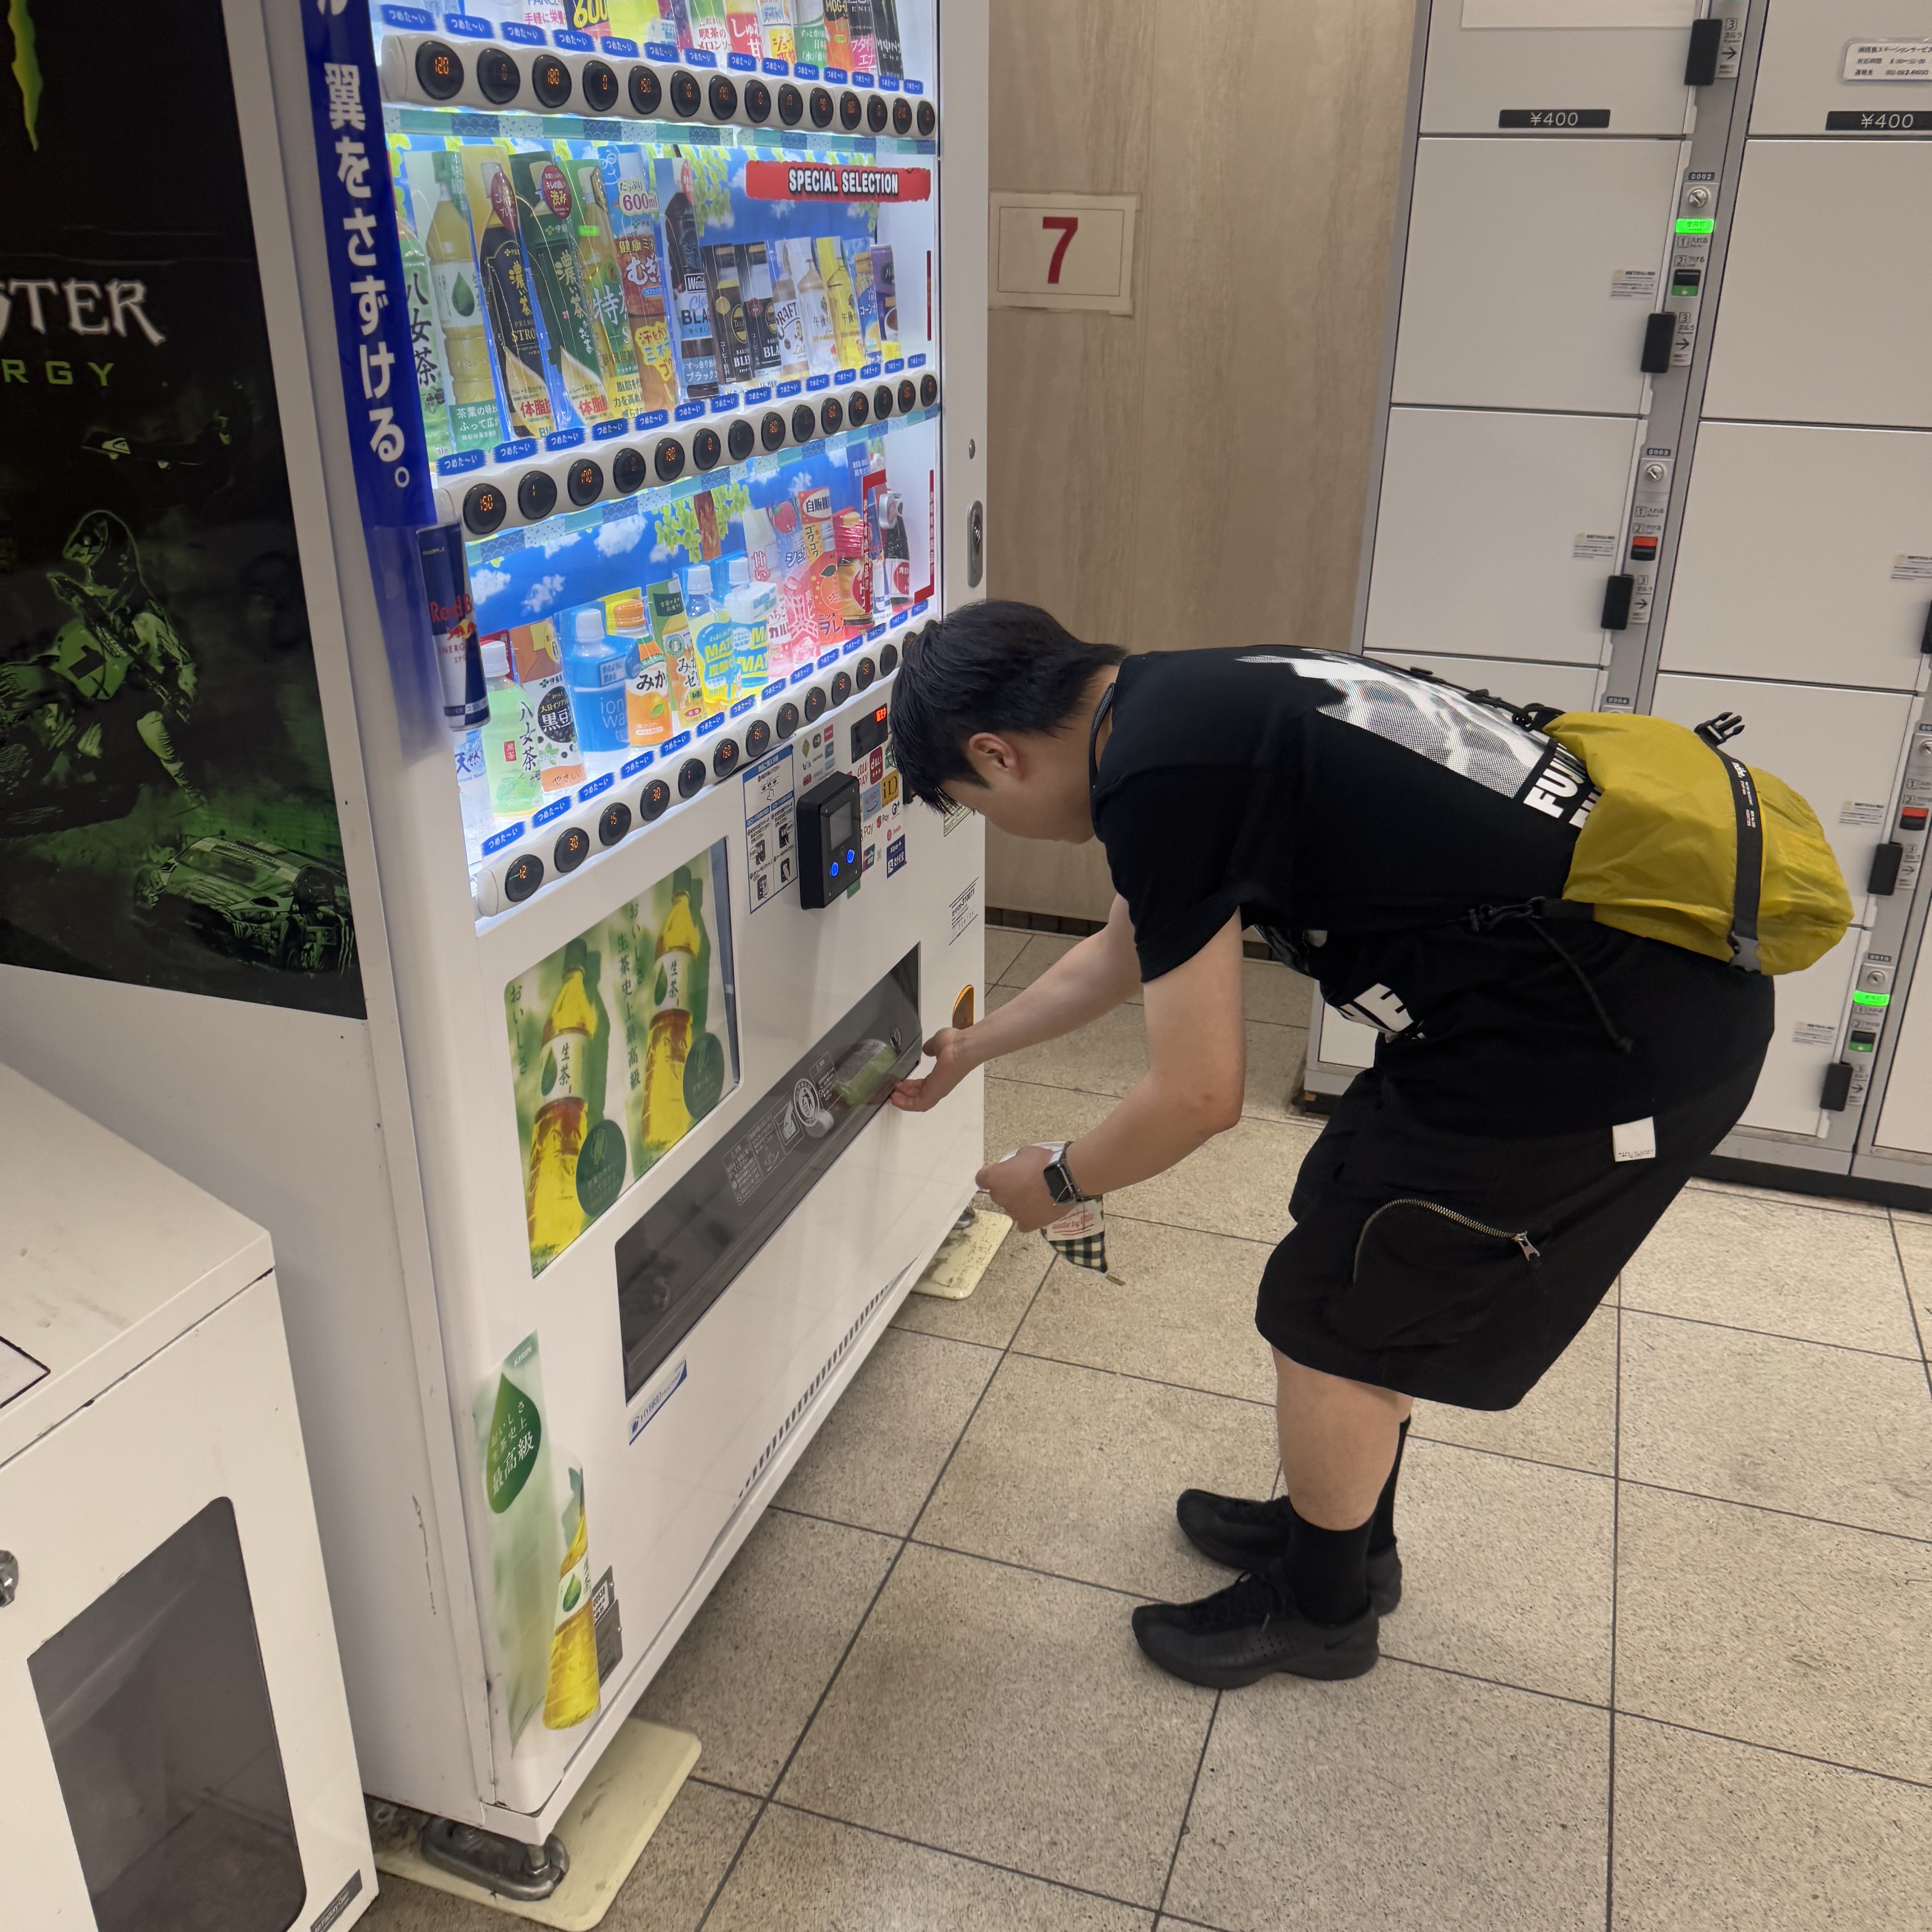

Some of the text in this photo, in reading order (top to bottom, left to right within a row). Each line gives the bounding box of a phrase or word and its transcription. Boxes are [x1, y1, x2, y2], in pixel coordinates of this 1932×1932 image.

[1530, 112, 1578, 126] ¥400
[1861, 113, 1914, 128] ¥400
[788, 167, 898, 195] SPECIAL SELECTION
[622, 191, 658, 212] 600ml
[1043, 216, 1078, 284] 7
[518, 701, 537, 772] 八女茶
[883, 776, 897, 799] iD
[668, 960, 678, 998] 生茶
[559, 1043, 570, 1086] 生茶
[513, 1345, 532, 1367] KIRIN
[492, 1431, 534, 1498] 最高級
